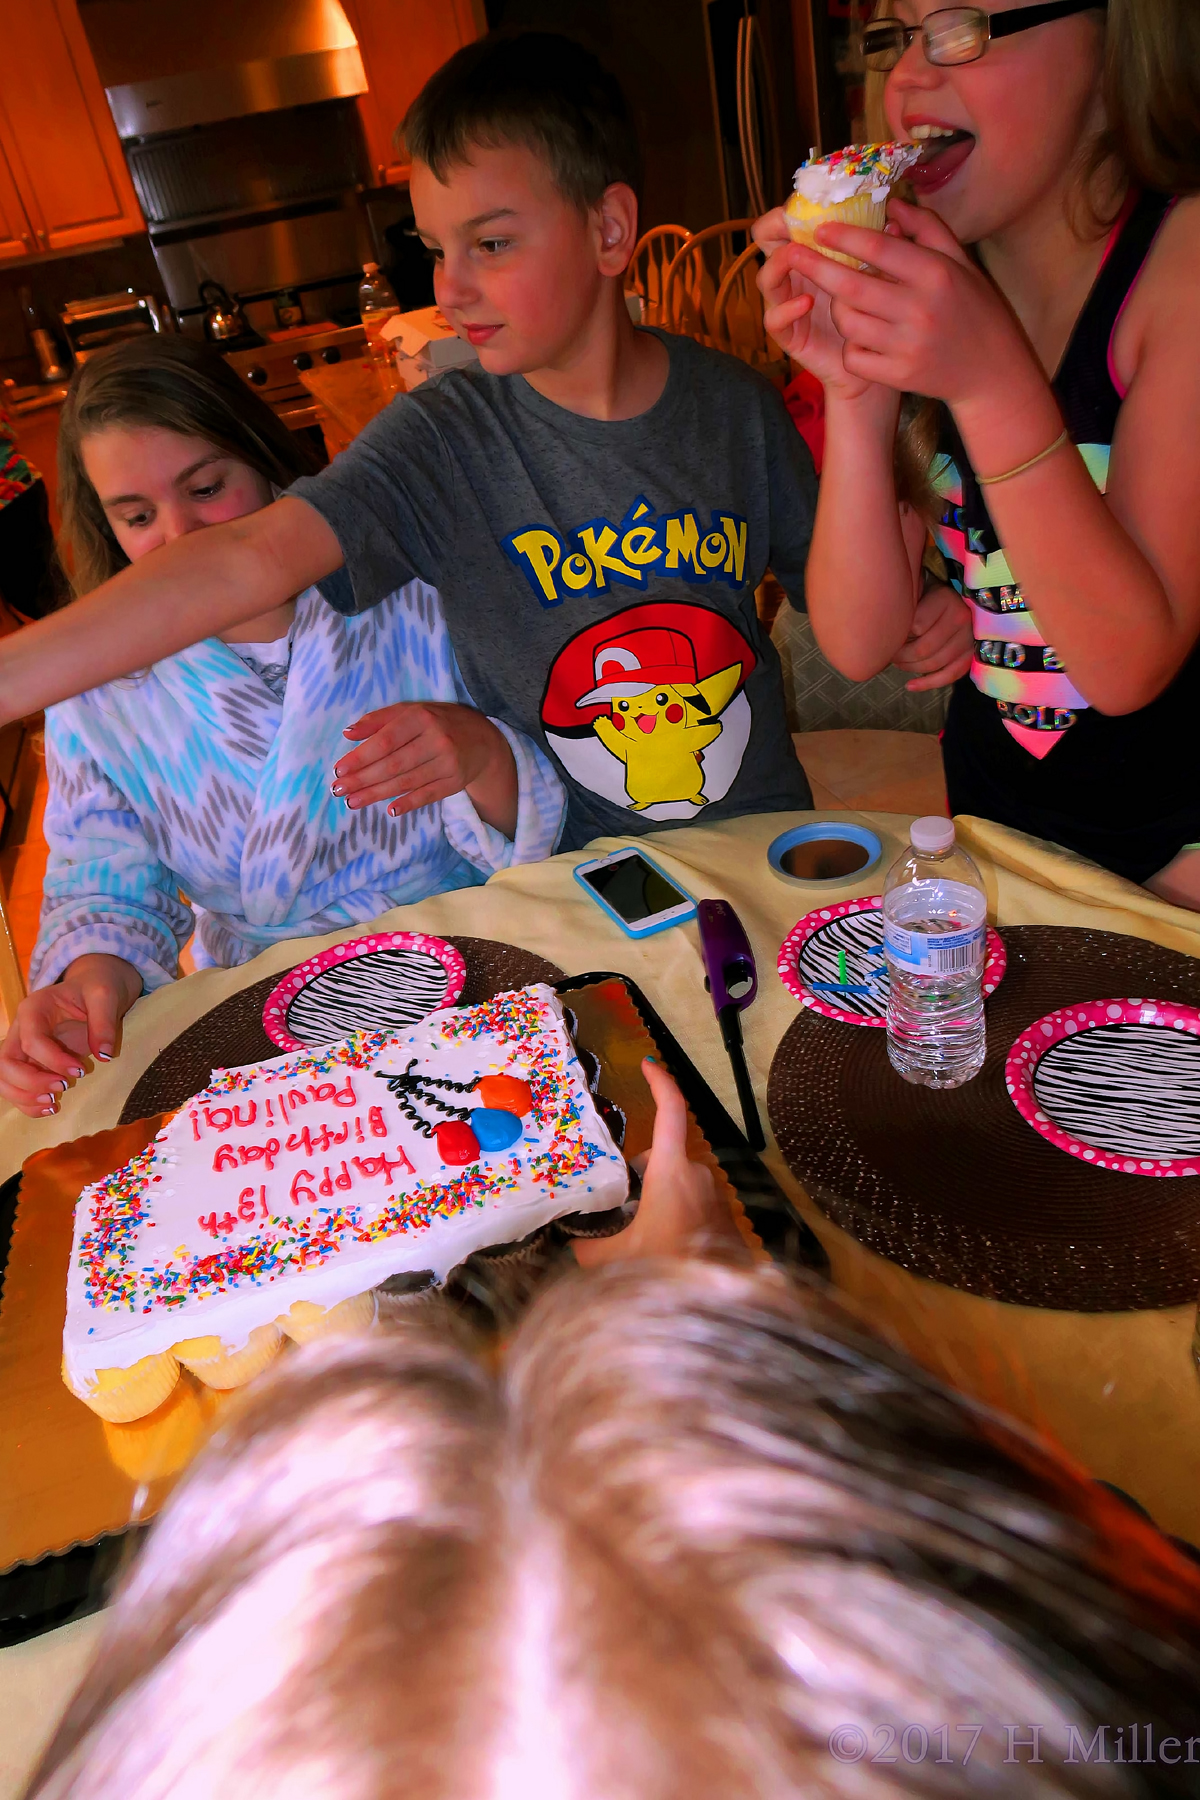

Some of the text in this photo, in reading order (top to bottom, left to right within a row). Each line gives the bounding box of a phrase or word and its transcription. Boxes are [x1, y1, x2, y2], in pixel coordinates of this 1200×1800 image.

[189, 1075, 358, 1142] Paulina!
[212, 1105, 388, 1173] Birthday
[197, 1144, 416, 1237] Happy 13th
